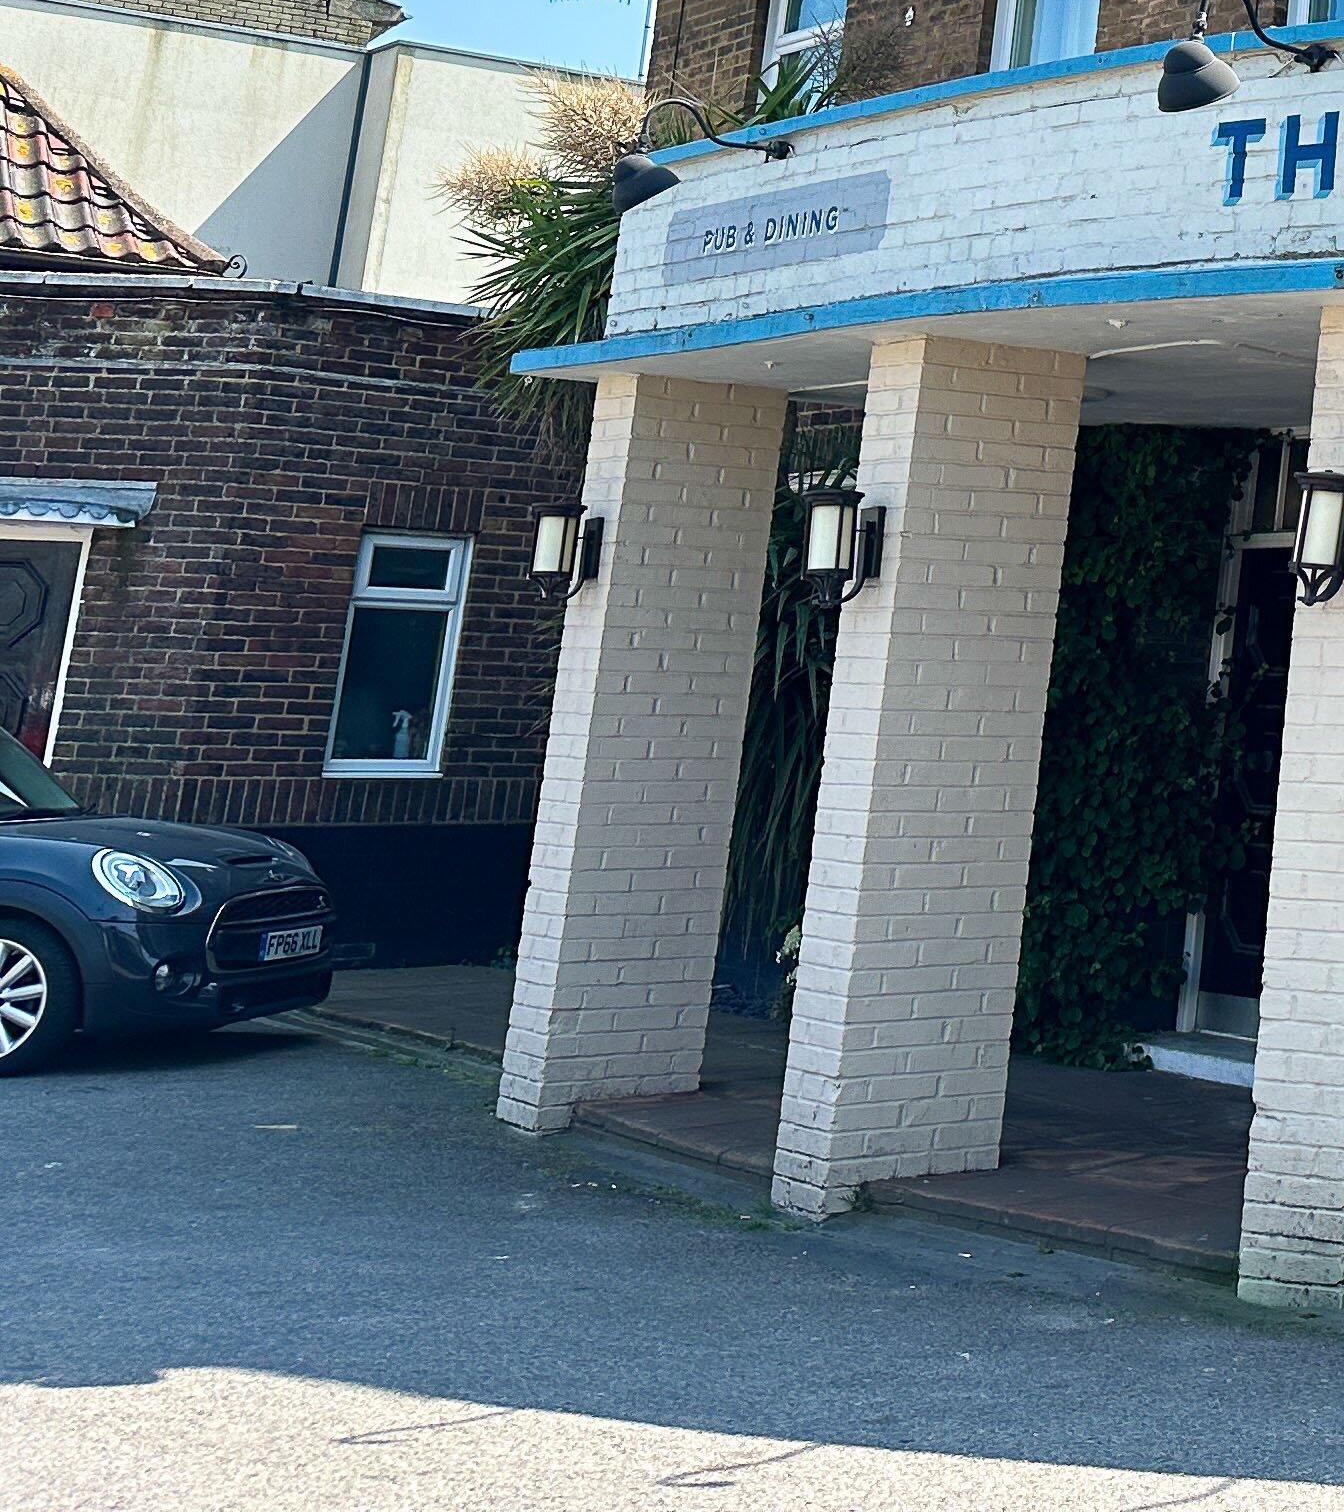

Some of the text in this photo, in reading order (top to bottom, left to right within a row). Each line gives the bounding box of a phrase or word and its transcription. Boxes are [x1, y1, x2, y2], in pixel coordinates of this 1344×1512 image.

[702, 206, 840, 253] PUB & DINING
[267, 933, 299, 955] FP66
